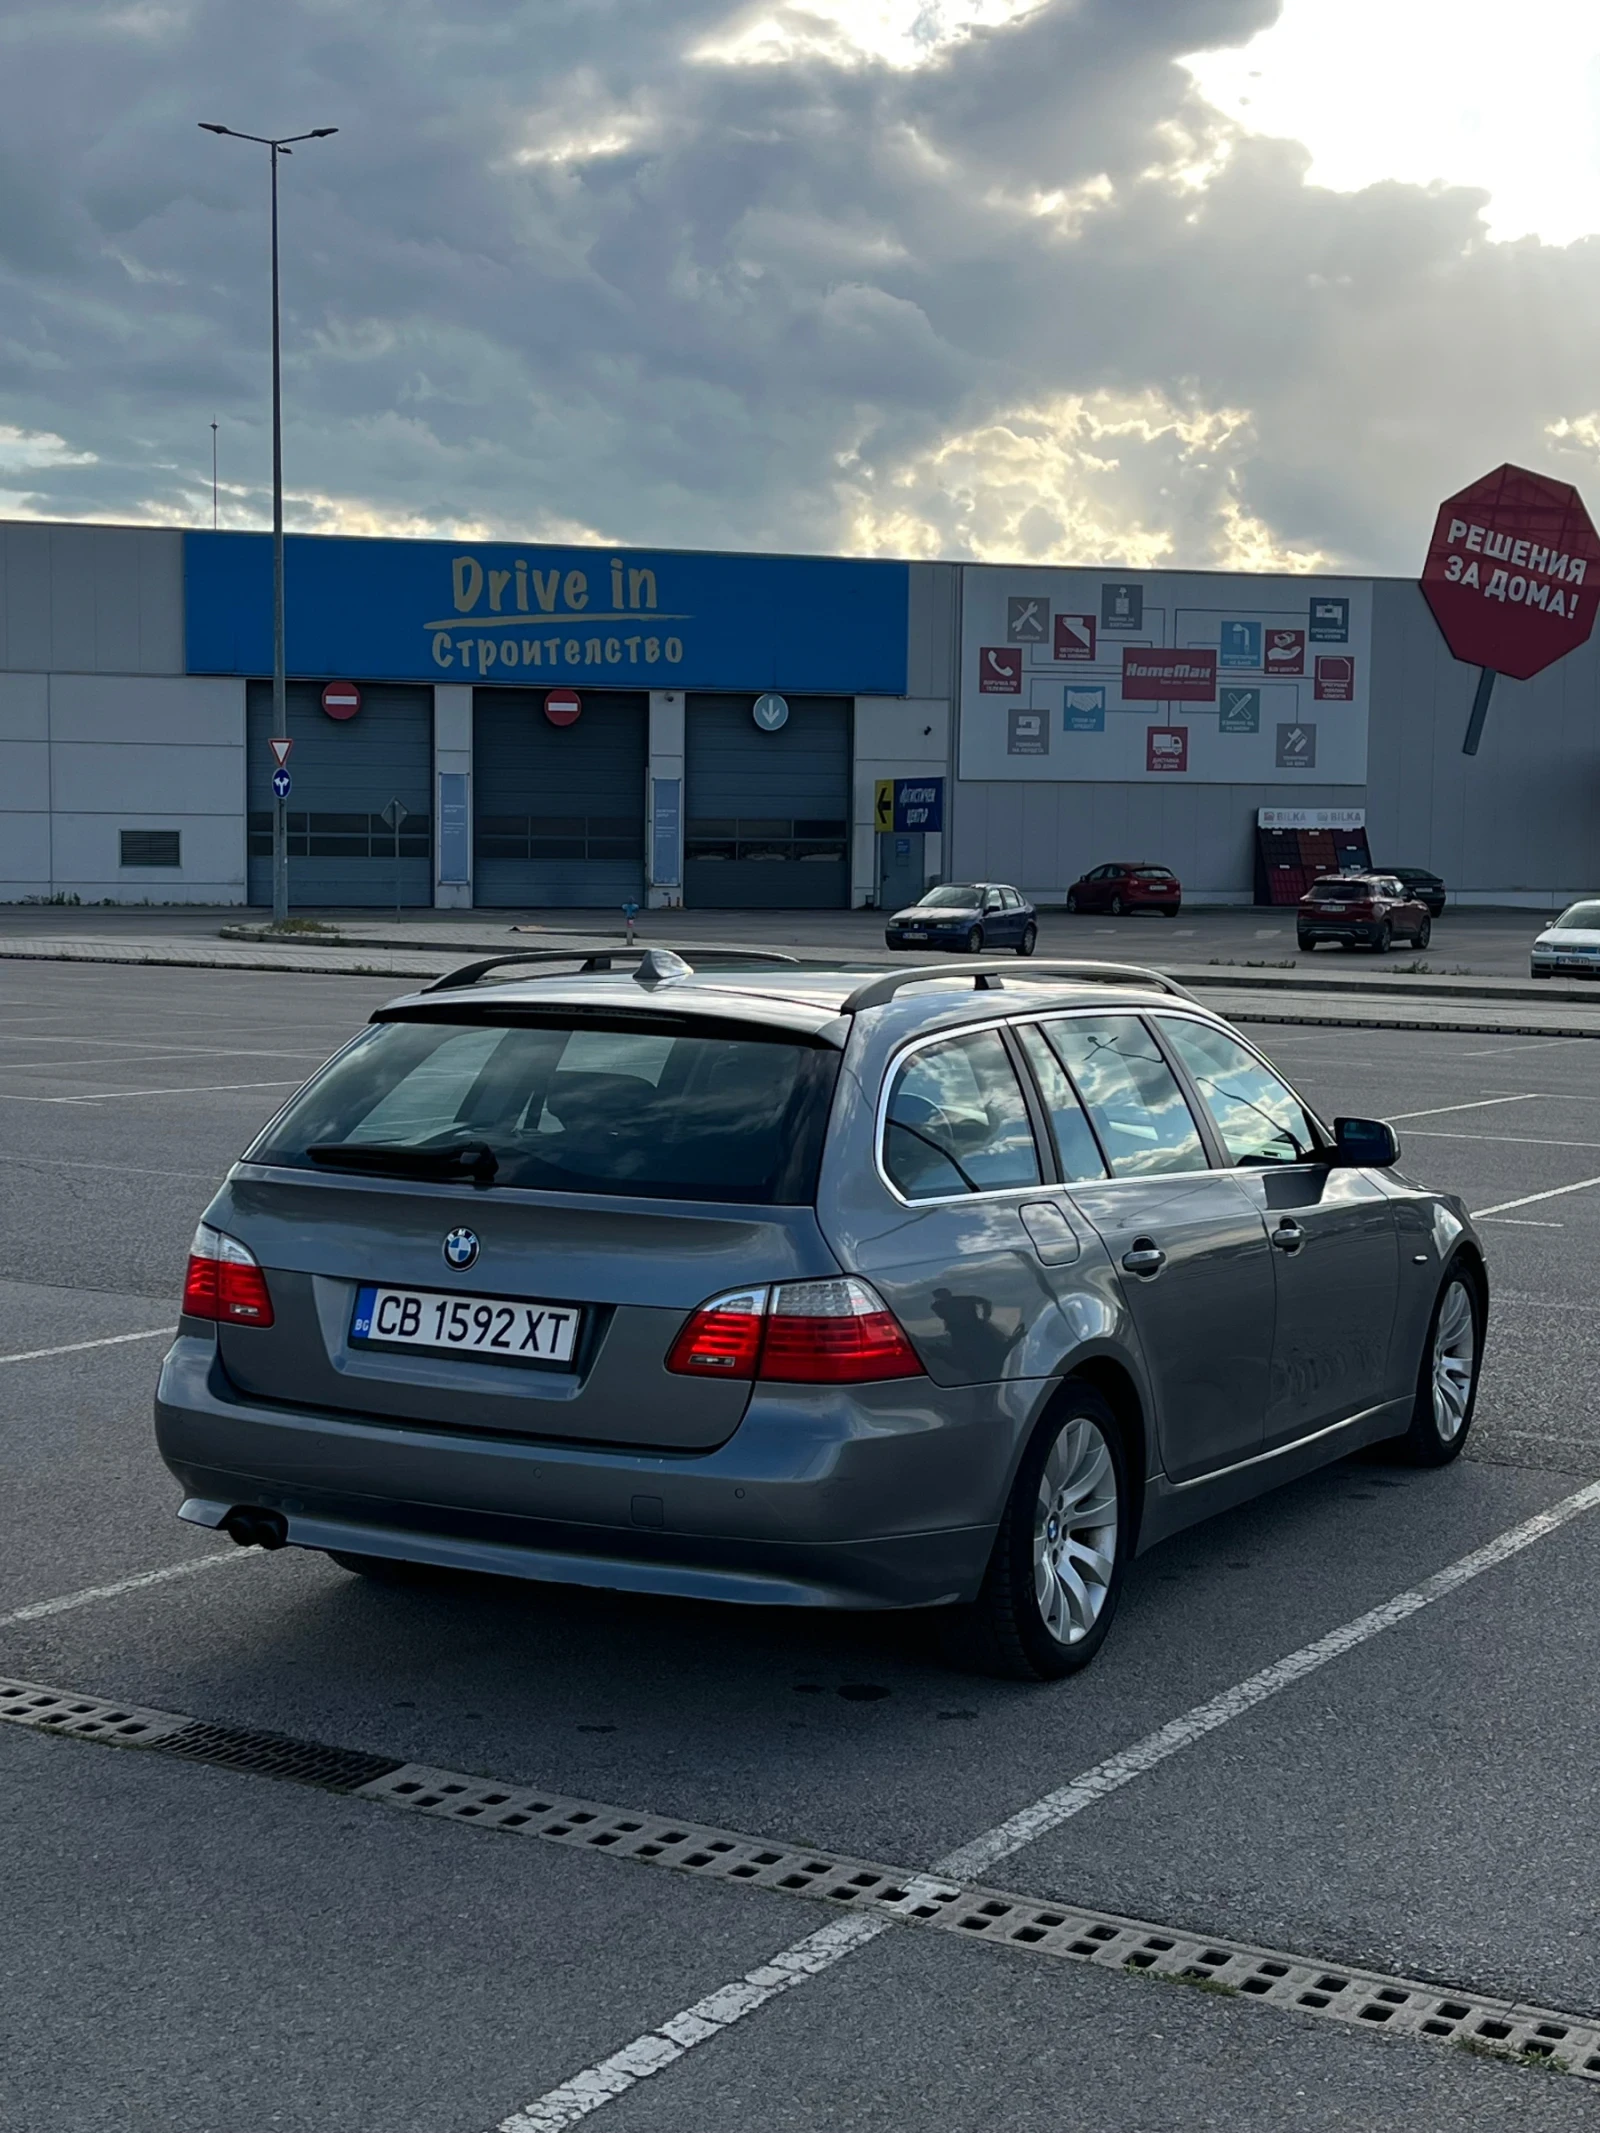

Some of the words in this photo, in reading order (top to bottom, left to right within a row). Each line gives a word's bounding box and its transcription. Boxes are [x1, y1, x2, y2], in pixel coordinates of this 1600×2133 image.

[1447, 518, 1587, 585] РЕШЕНИЯ
[452, 556, 589, 612] Drive
[610, 558, 657, 610] in
[1444, 555, 1480, 590] ЗА
[1484, 568, 1579, 620] ДОМА!
[431, 632, 683, 675] Строителство
[1277, 812, 1307, 821] BILKA
[1331, 812, 1362, 821] BILKA
[355, 1319, 369, 1331] BG
[377, 1296, 421, 1337] CB
[435, 1301, 515, 1348] 1592
[519, 1310, 570, 1353] XT
